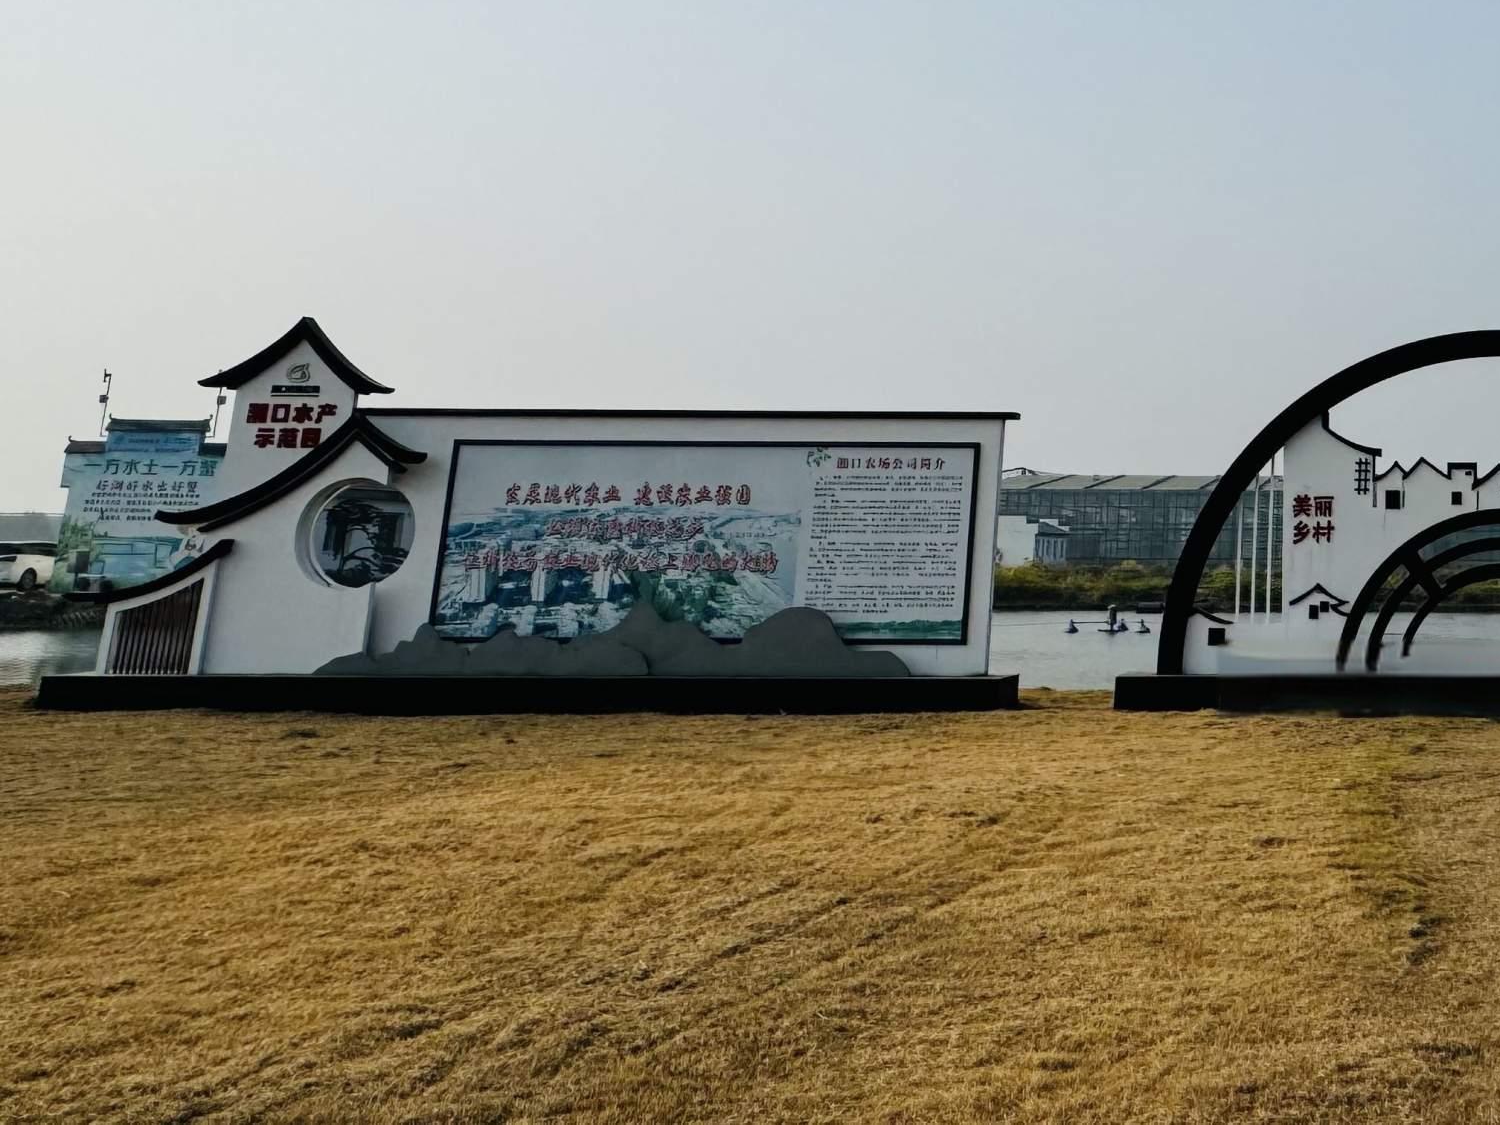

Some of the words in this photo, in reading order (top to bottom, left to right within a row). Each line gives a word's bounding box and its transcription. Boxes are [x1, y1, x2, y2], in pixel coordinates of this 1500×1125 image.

[254, 428, 322, 449] 示范园
[84, 458, 219, 477] 一方水土一方蟹
[504, 482, 622, 507] 发展现代农业
[1292, 494, 1335, 518] 美丽
[1292, 519, 1335, 545] 乡村
